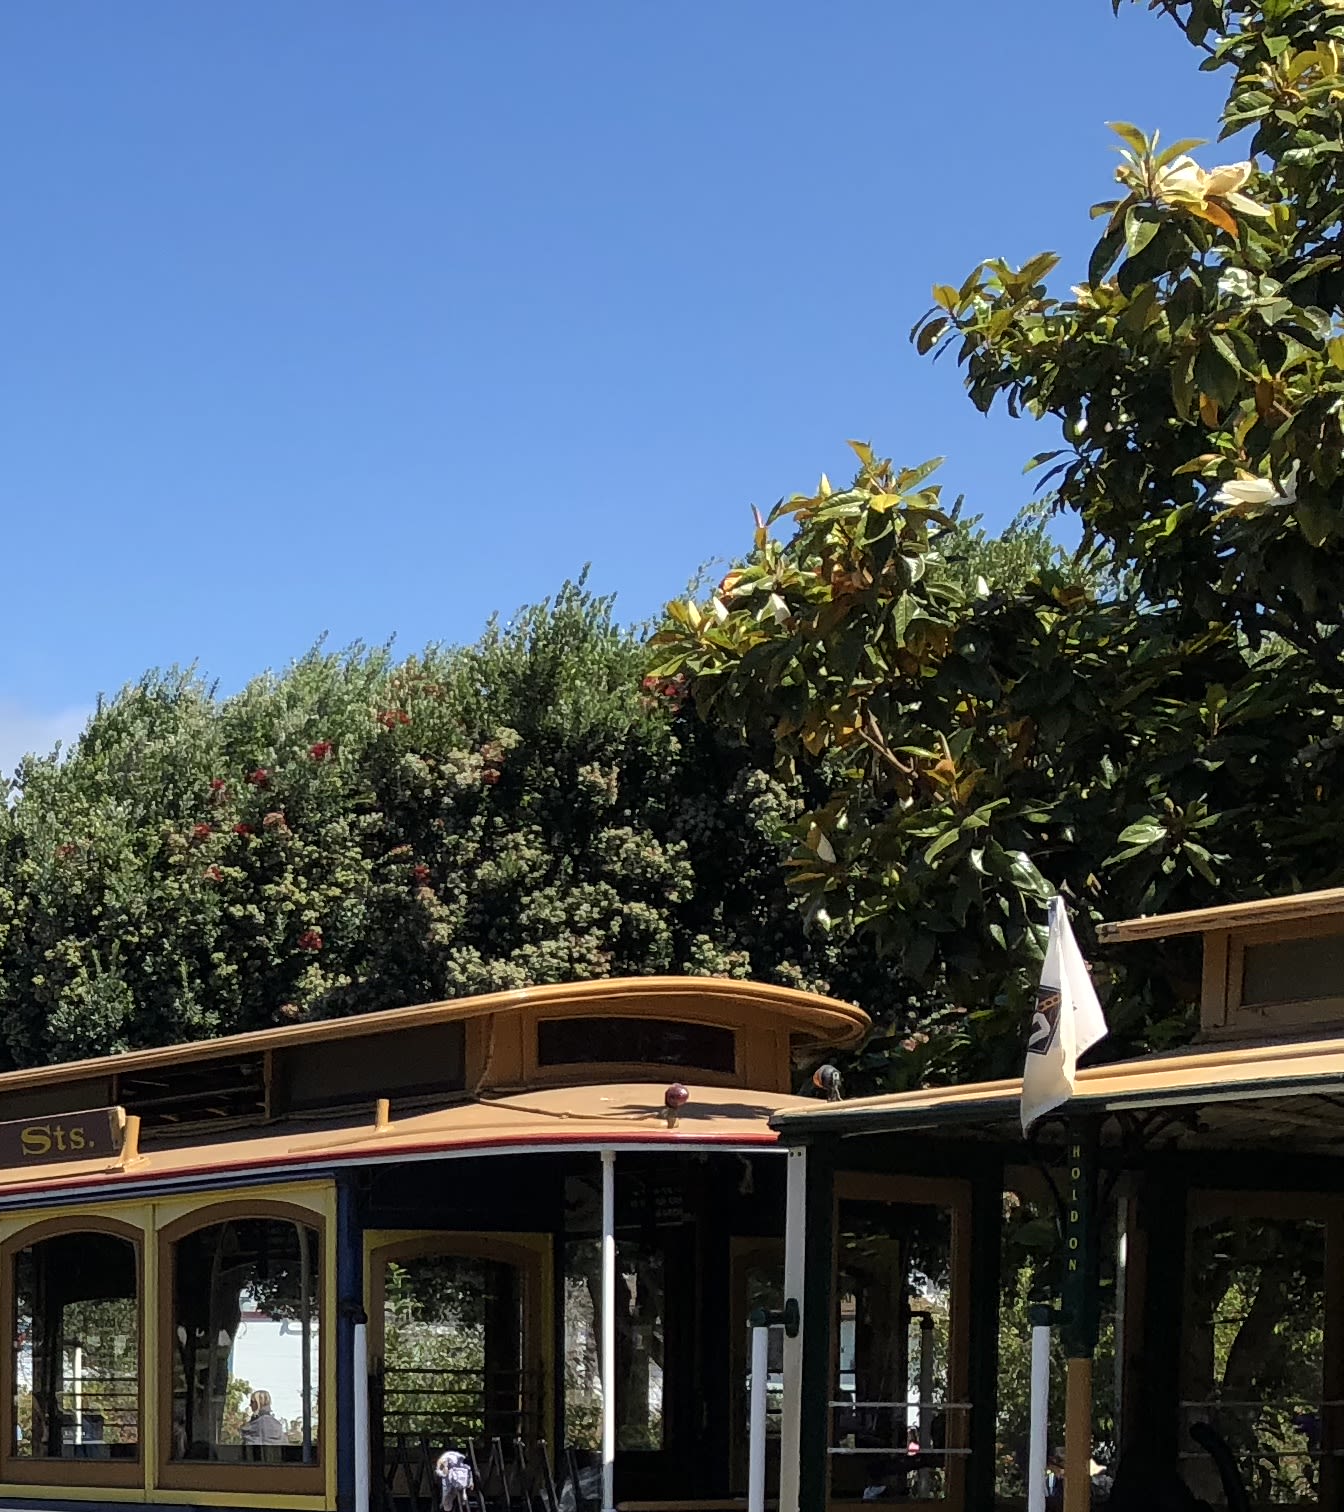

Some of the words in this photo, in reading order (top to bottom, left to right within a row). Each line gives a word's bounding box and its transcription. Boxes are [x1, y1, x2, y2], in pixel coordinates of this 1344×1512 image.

[20, 1124, 96, 1157] Sts.
[1070, 1144, 1082, 1223] HOLD
[1068, 1236, 1078, 1271] ON
